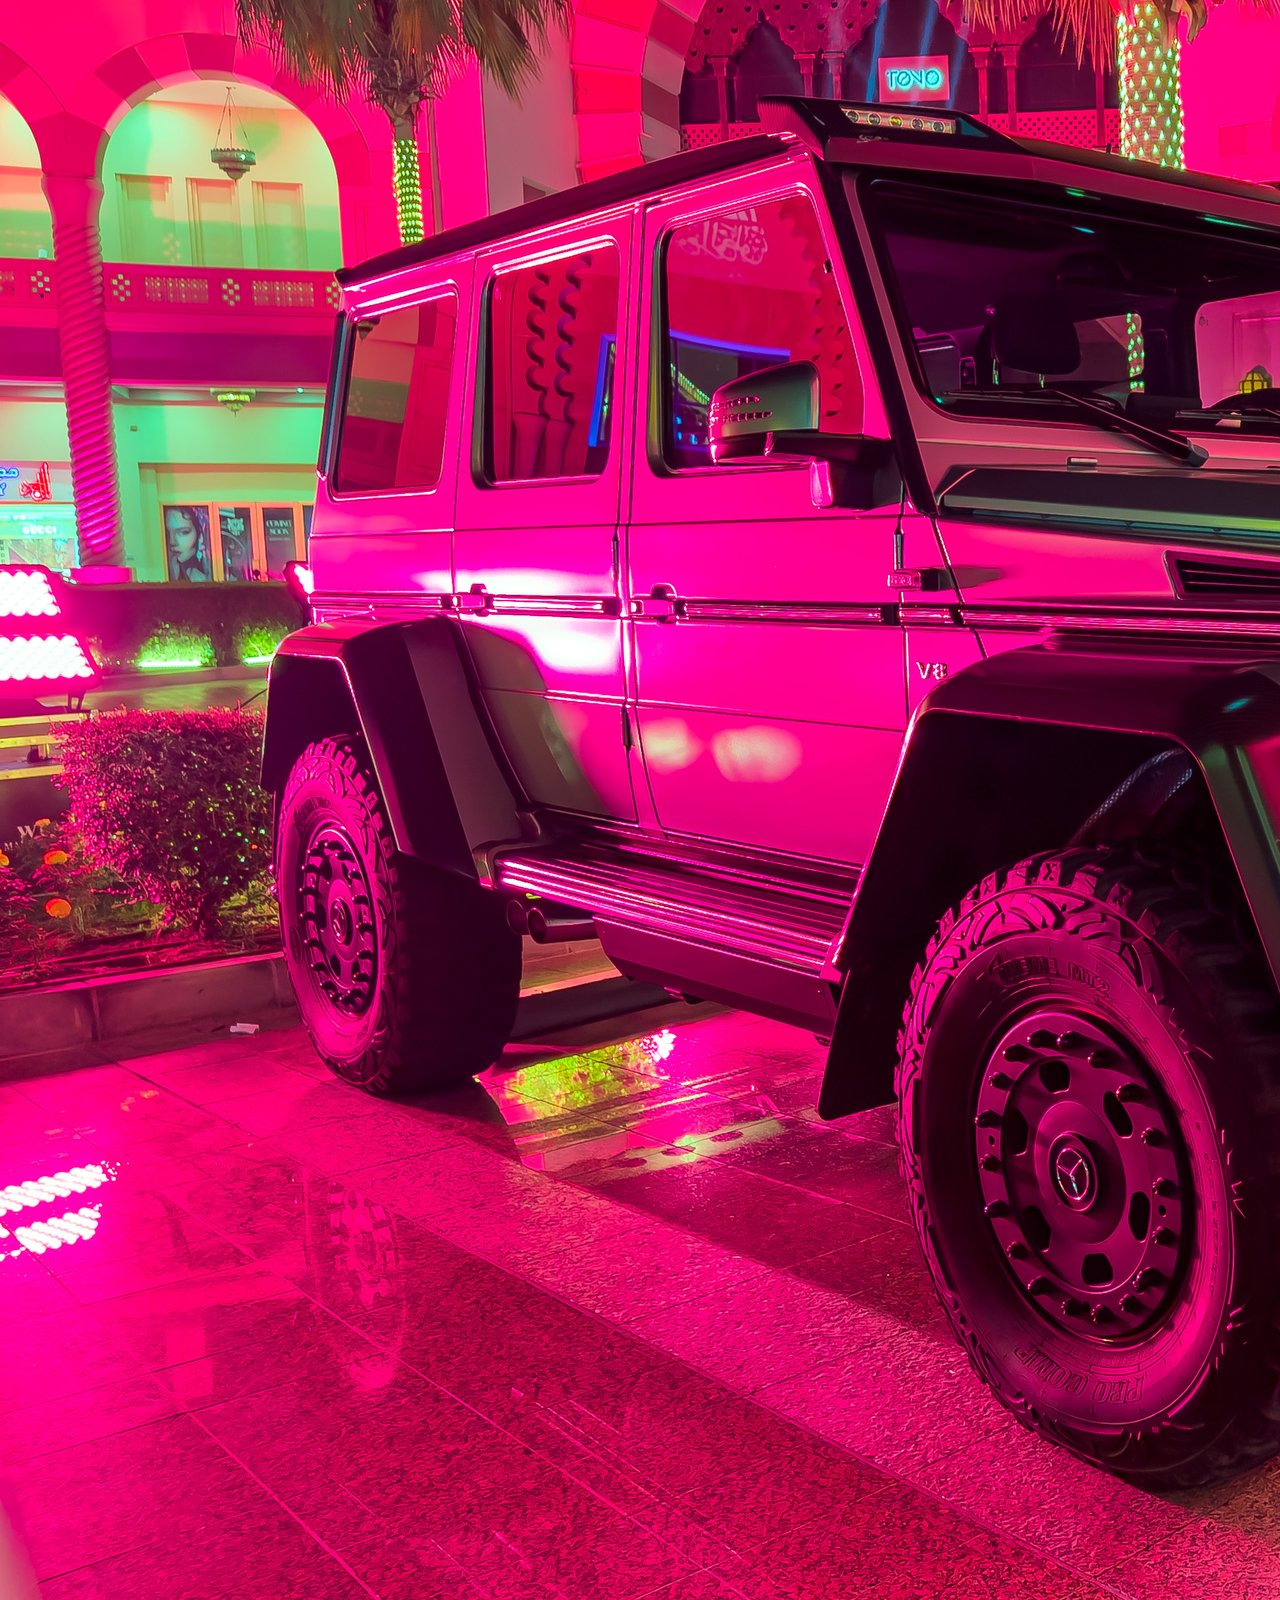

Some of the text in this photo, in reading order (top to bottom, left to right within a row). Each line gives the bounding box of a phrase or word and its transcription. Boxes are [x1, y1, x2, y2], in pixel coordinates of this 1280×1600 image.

[22, 525, 57, 535] GUCCI
[916, 661, 948, 680] V8
[1014, 1345, 1088, 1396] COMP
[1092, 1373, 1145, 1404] PRO
